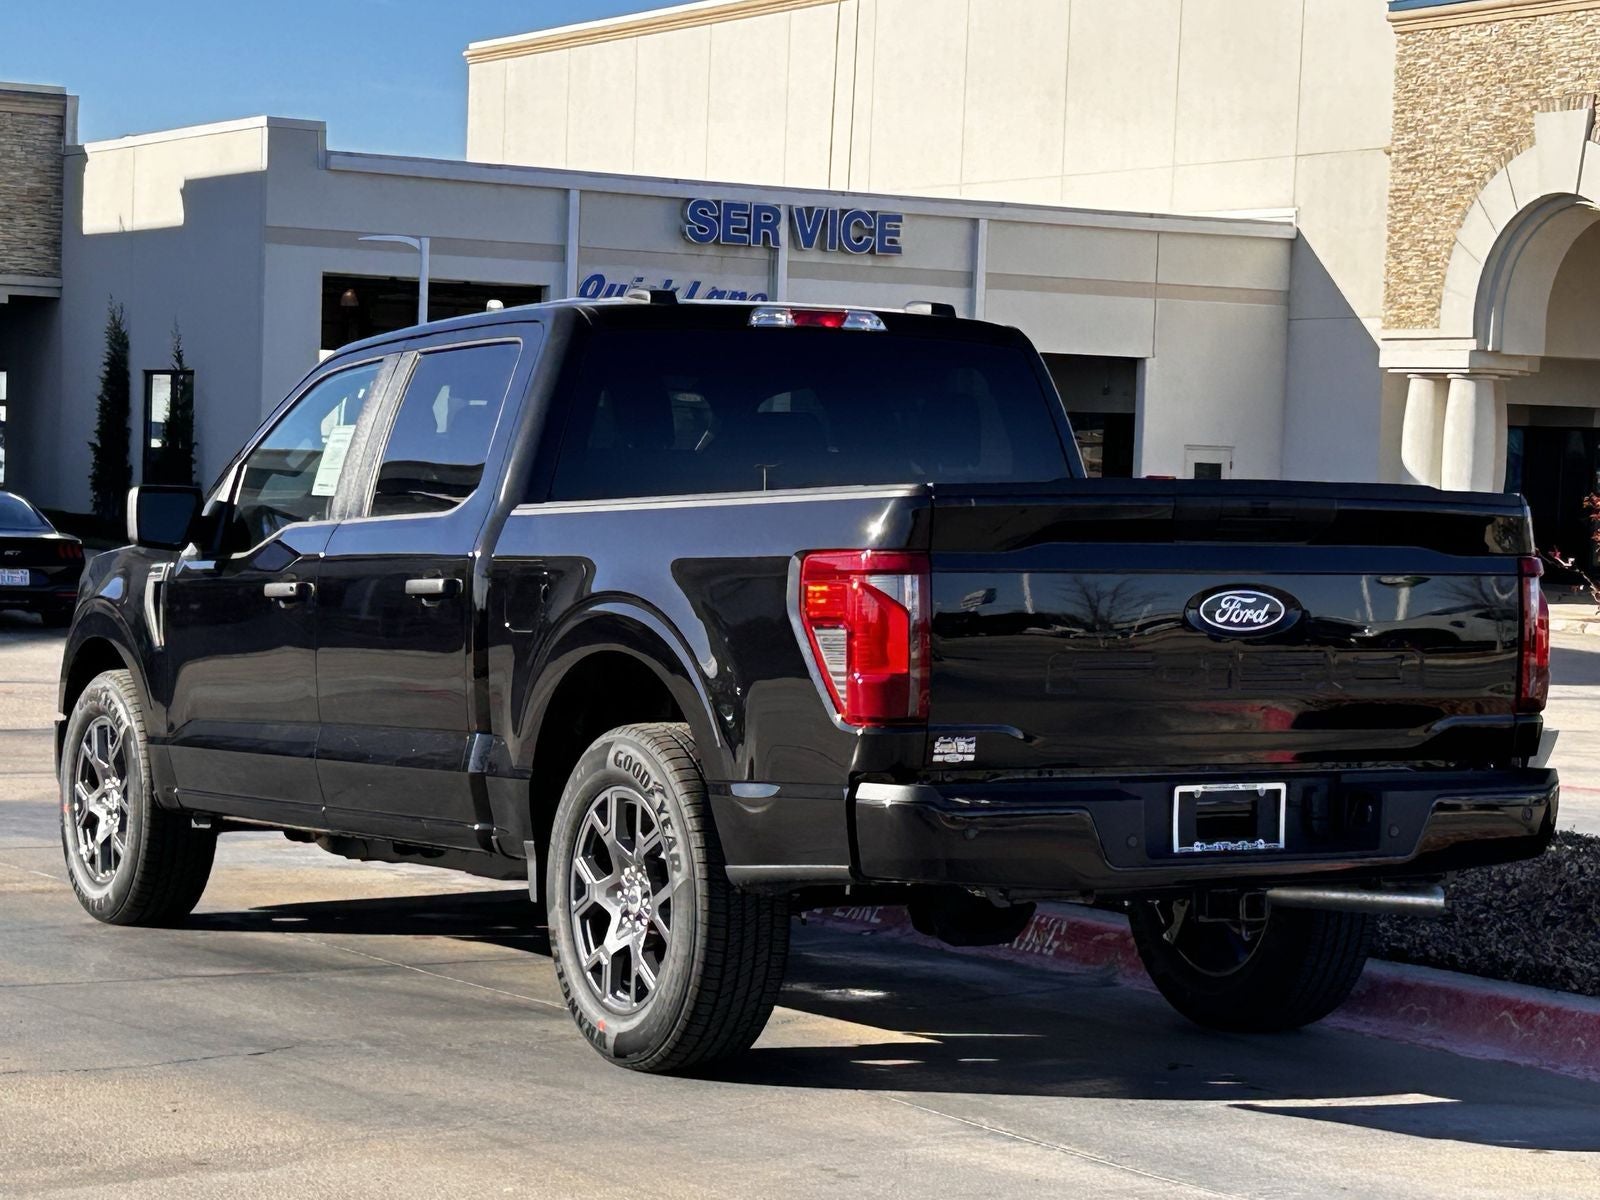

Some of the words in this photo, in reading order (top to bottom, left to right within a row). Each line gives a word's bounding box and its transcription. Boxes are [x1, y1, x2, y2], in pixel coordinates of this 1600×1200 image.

[684, 198, 903, 255] SERVICE
[1214, 595, 1270, 623] Ford
[613, 750, 682, 873] GOODYEAR
